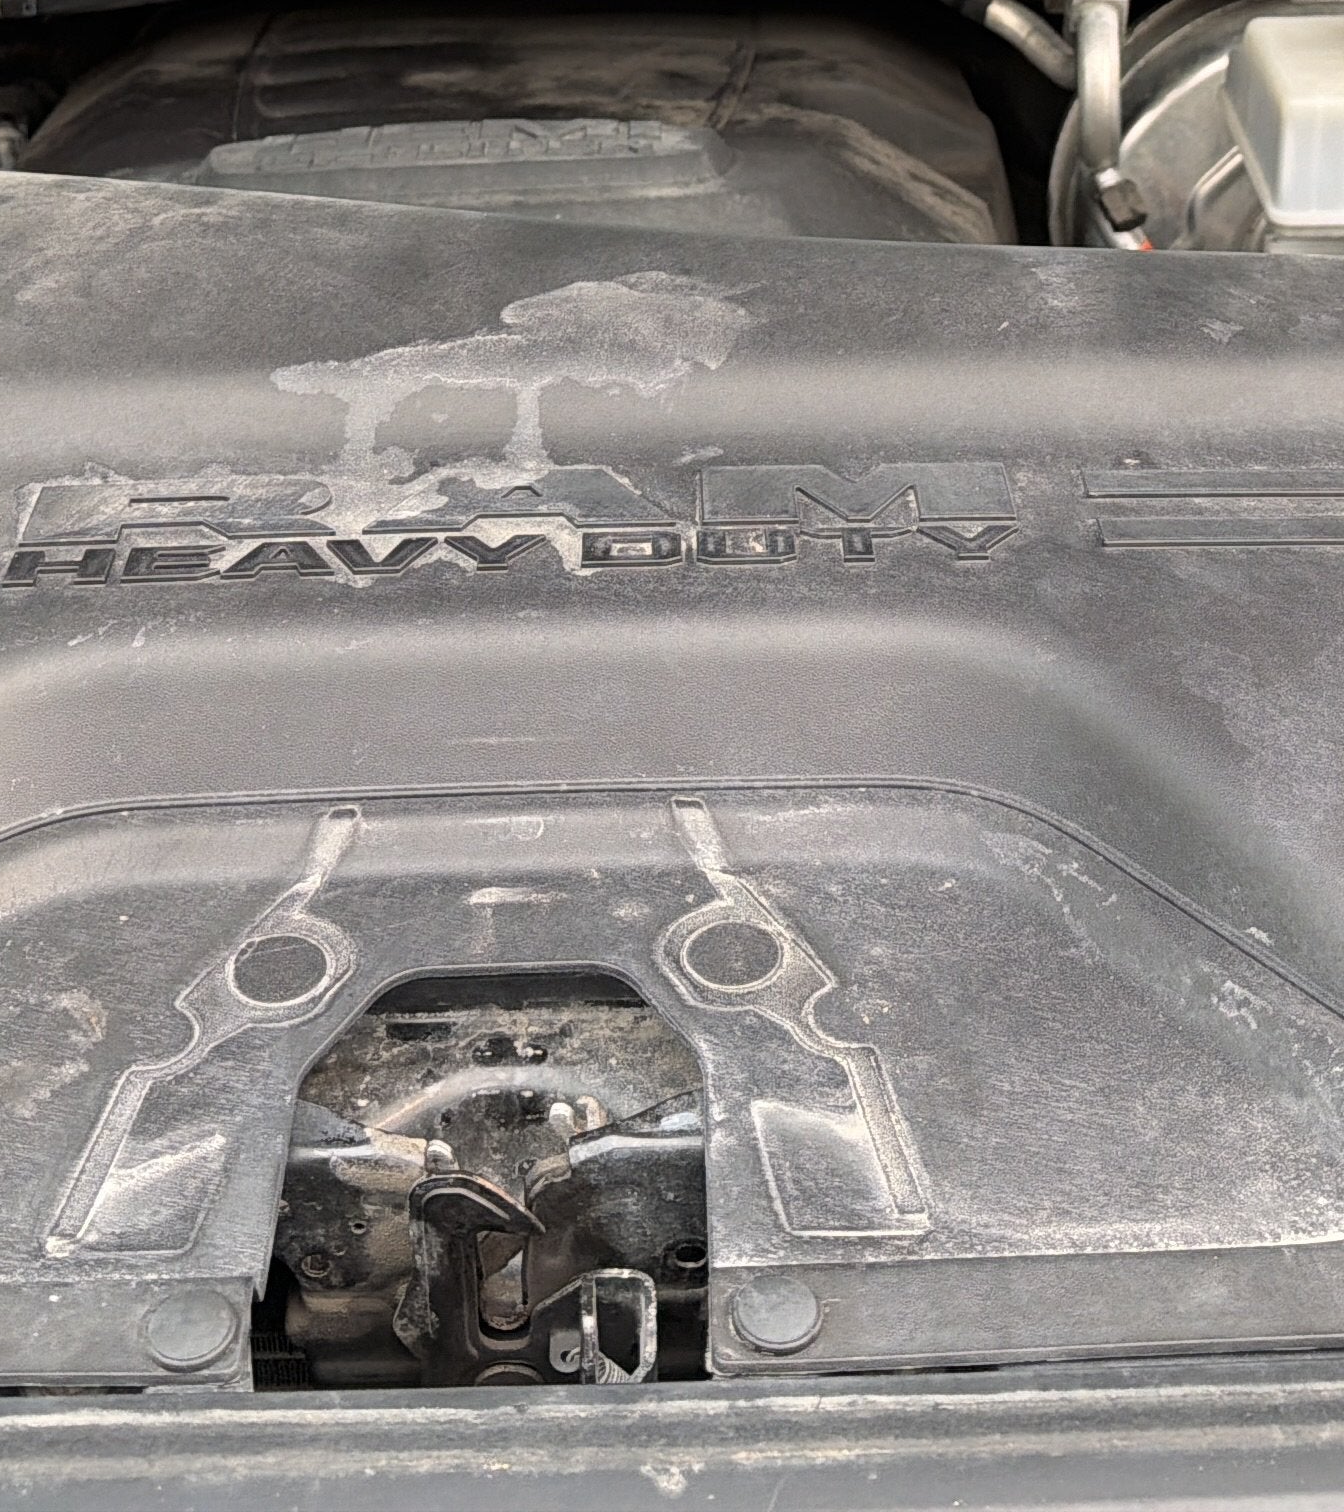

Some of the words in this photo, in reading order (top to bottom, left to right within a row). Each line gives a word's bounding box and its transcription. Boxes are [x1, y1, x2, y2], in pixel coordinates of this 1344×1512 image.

[18, 461, 1019, 547] RAM
[2, 533, 550, 587] HEAVY
[580, 518, 1021, 569] DUTY
